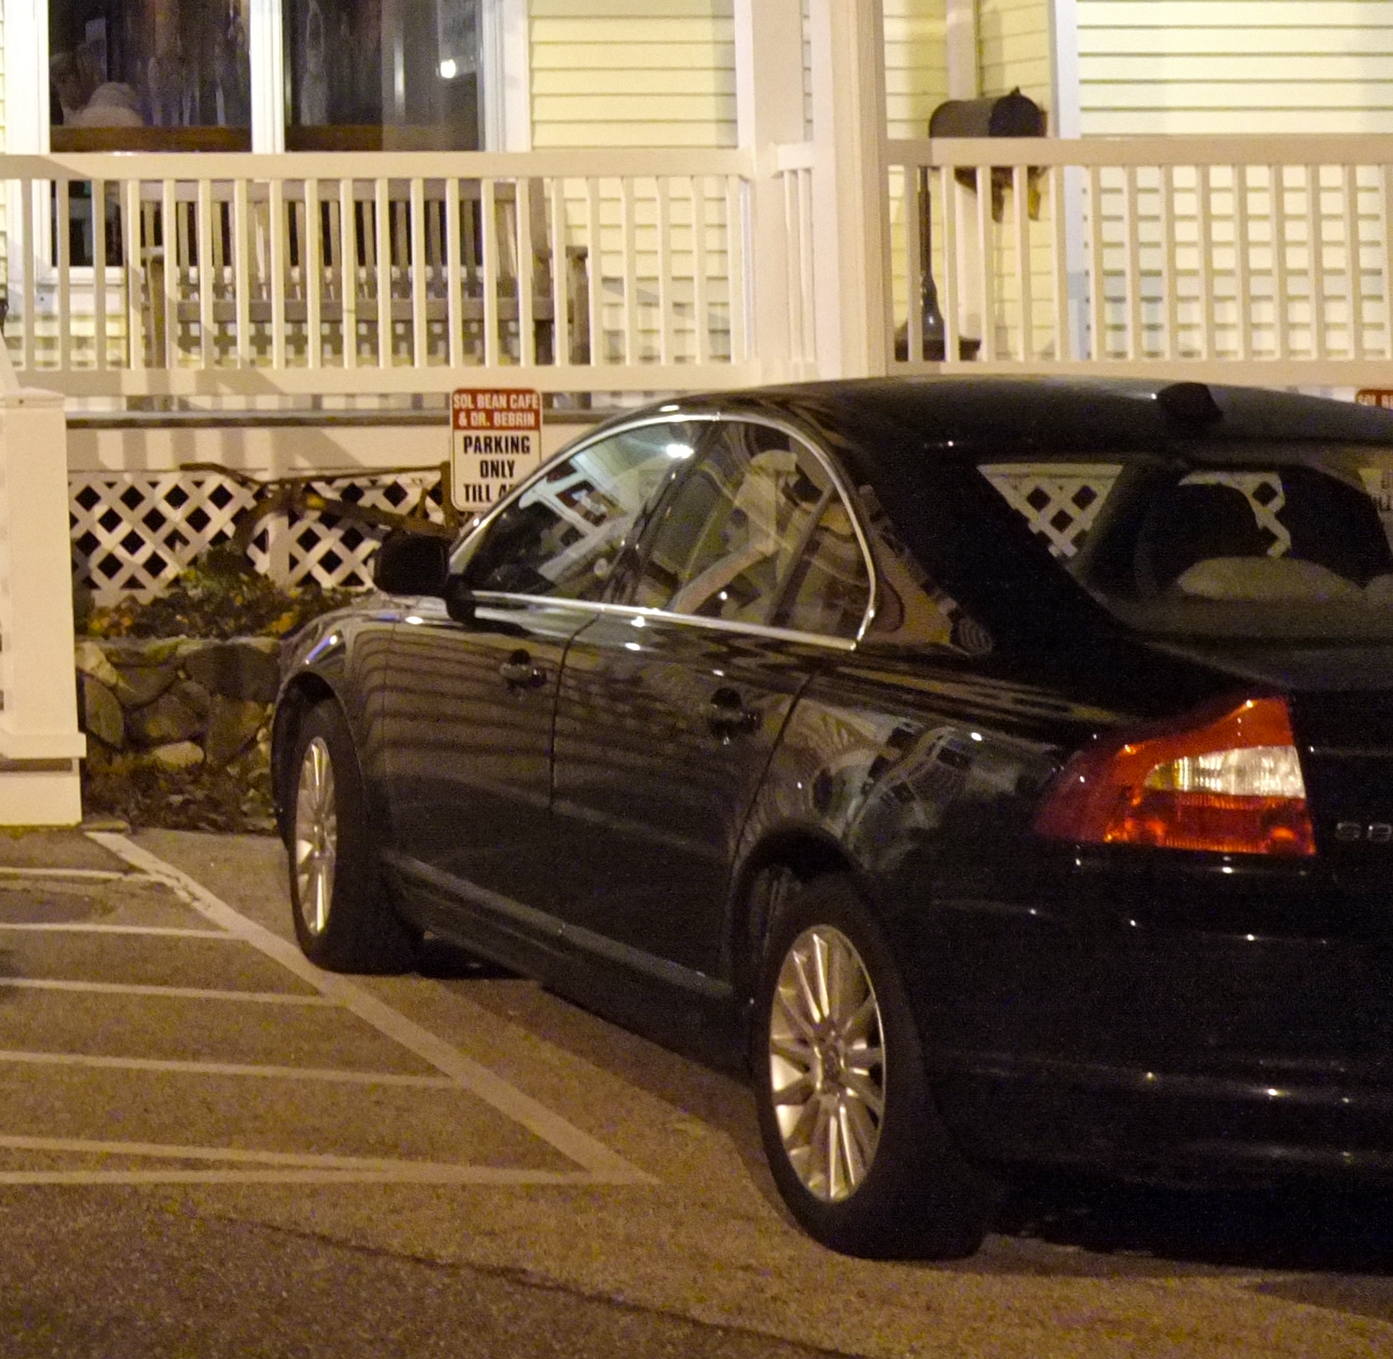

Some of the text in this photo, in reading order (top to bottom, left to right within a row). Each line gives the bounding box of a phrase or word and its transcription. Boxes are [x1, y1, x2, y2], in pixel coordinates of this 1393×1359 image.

[453, 393, 538, 409] SOL BEAN CAFE
[458, 411, 468, 427] &
[463, 435, 530, 454] PARKING
[480, 460, 515, 478] ONLY
[464, 484, 491, 502] TILL
